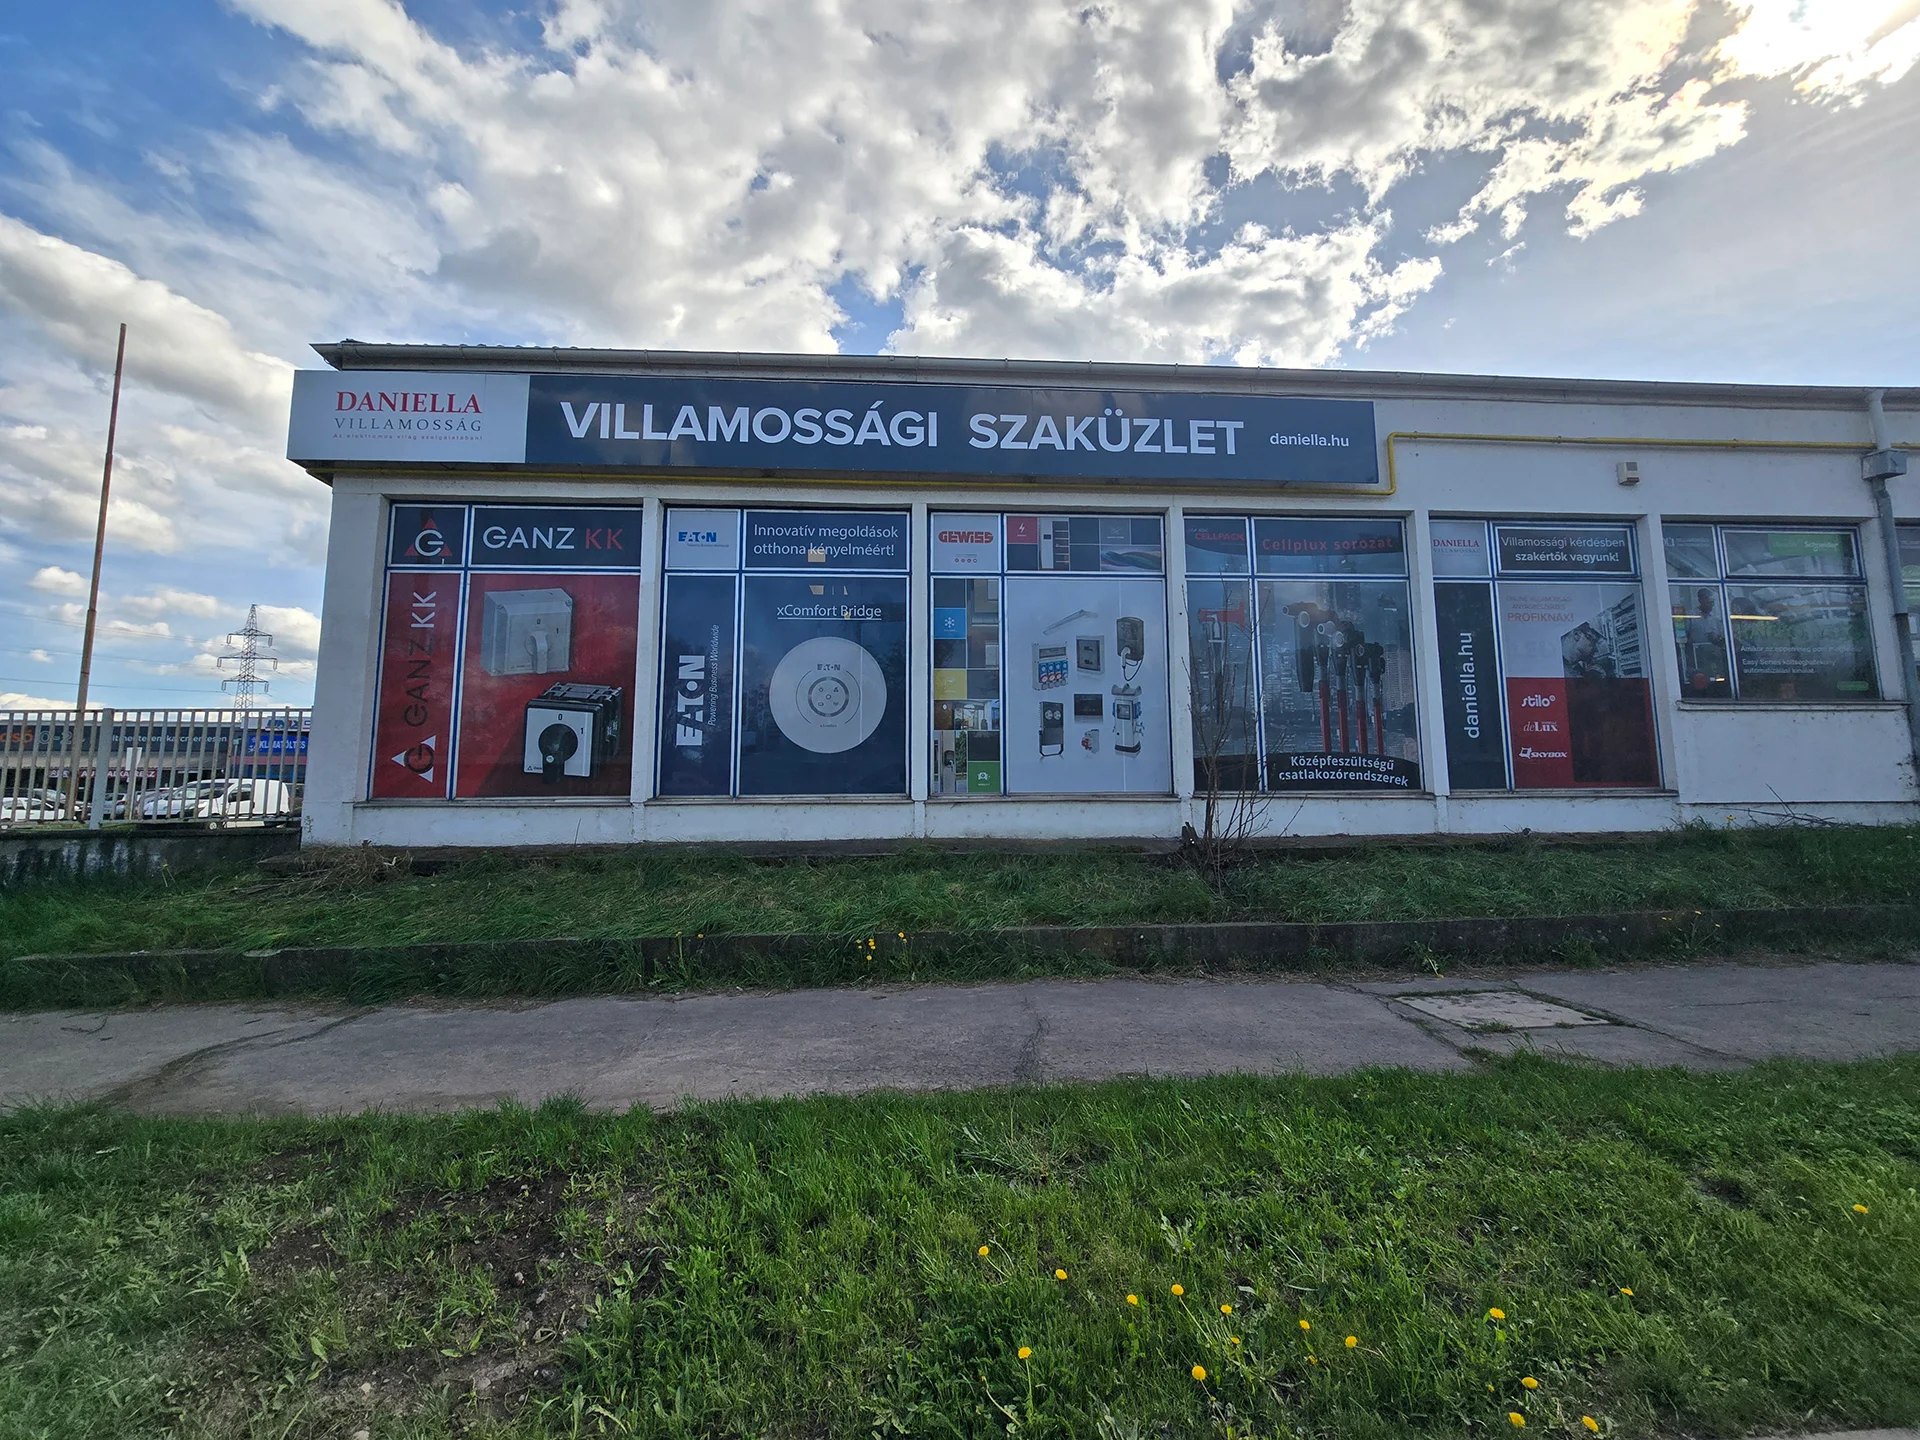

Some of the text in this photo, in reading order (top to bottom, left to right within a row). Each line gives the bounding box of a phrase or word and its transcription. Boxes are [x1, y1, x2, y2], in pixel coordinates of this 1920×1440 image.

[335, 391, 482, 414] DANIELLA
[335, 417, 482, 432] VILLAMOSSÁG
[560, 400, 1349, 455] VILLAMOSSÁGI SZAKÜZLET daniella.hu
[482, 526, 624, 550] GANZ KK
[678, 531, 717, 543] EATON
[754, 524, 899, 542] Innovatív megoldások
[1195, 533, 1245, 541] CELLPACK
[1262, 538, 1393, 554] Cellplux sorozat
[1433, 538, 1480, 548] DANIELLA
[1501, 536, 1625, 549] Villamossági kérdésben
[754, 543, 895, 559] otthona kényelméért!
[1515, 551, 1619, 564] szakértők vagyunk!
[410, 591, 437, 628] KK
[776, 604, 882, 619] xComfort Bridge
[1507, 612, 1574, 622] PROFIKNAK!
[404, 639, 434, 727] GANZ
[708, 625, 720, 726] Powering Business Worldwide
[1458, 632, 1480, 739] daniella.hu
[676, 655, 705, 746] EATON
[558, 712, 563, 721] 0
[1290, 756, 1395, 771] Középfeszültségű
[1278, 769, 1409, 787] csatlakozórendszerek
